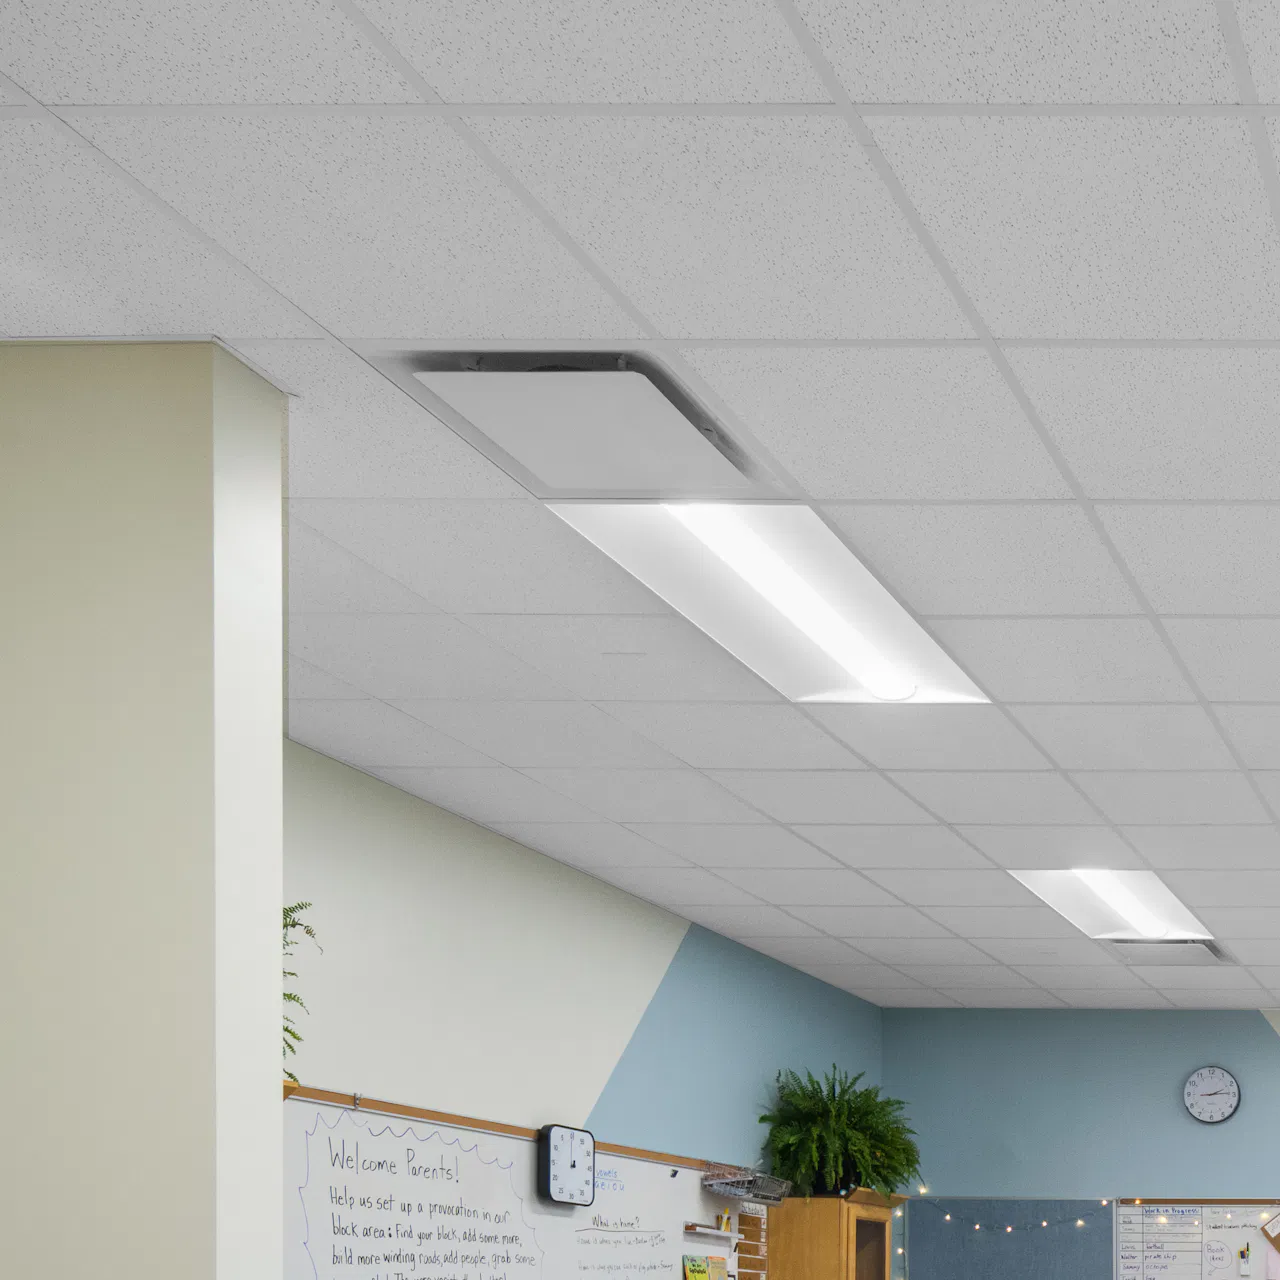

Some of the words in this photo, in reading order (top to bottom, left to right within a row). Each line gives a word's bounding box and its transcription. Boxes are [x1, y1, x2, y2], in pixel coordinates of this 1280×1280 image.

[328, 1136, 397, 1175] Welcome
[406, 1148, 460, 1183] Parents!
[329, 1185, 355, 1210] Help
[359, 1196, 373, 1209] us
[376, 1194, 396, 1211] set
[400, 1202, 412, 1217] up
[417, 1203, 424, 1213] a
[429, 1197, 479, 1219] provocation
[482, 1207, 491, 1220] in
[494, 1210, 511, 1224] our
[1144, 1206, 1161, 1215] Work
[331, 1212, 358, 1236] block
[395, 1223, 414, 1239] Find
[416, 1231, 434, 1247] your
[462, 1228, 477, 1242] add
[479, 1232, 501, 1245] some
[592, 1213, 610, 1228] What
[332, 1244, 353, 1266] build
[357, 1254, 381, 1266] more
[383, 1248, 416, 1271] winding
[443, 1249, 459, 1265] add
[491, 1250, 512, 1270] grab
[514, 1254, 537, 1267] some
[1206, 1243, 1225, 1254] Book
